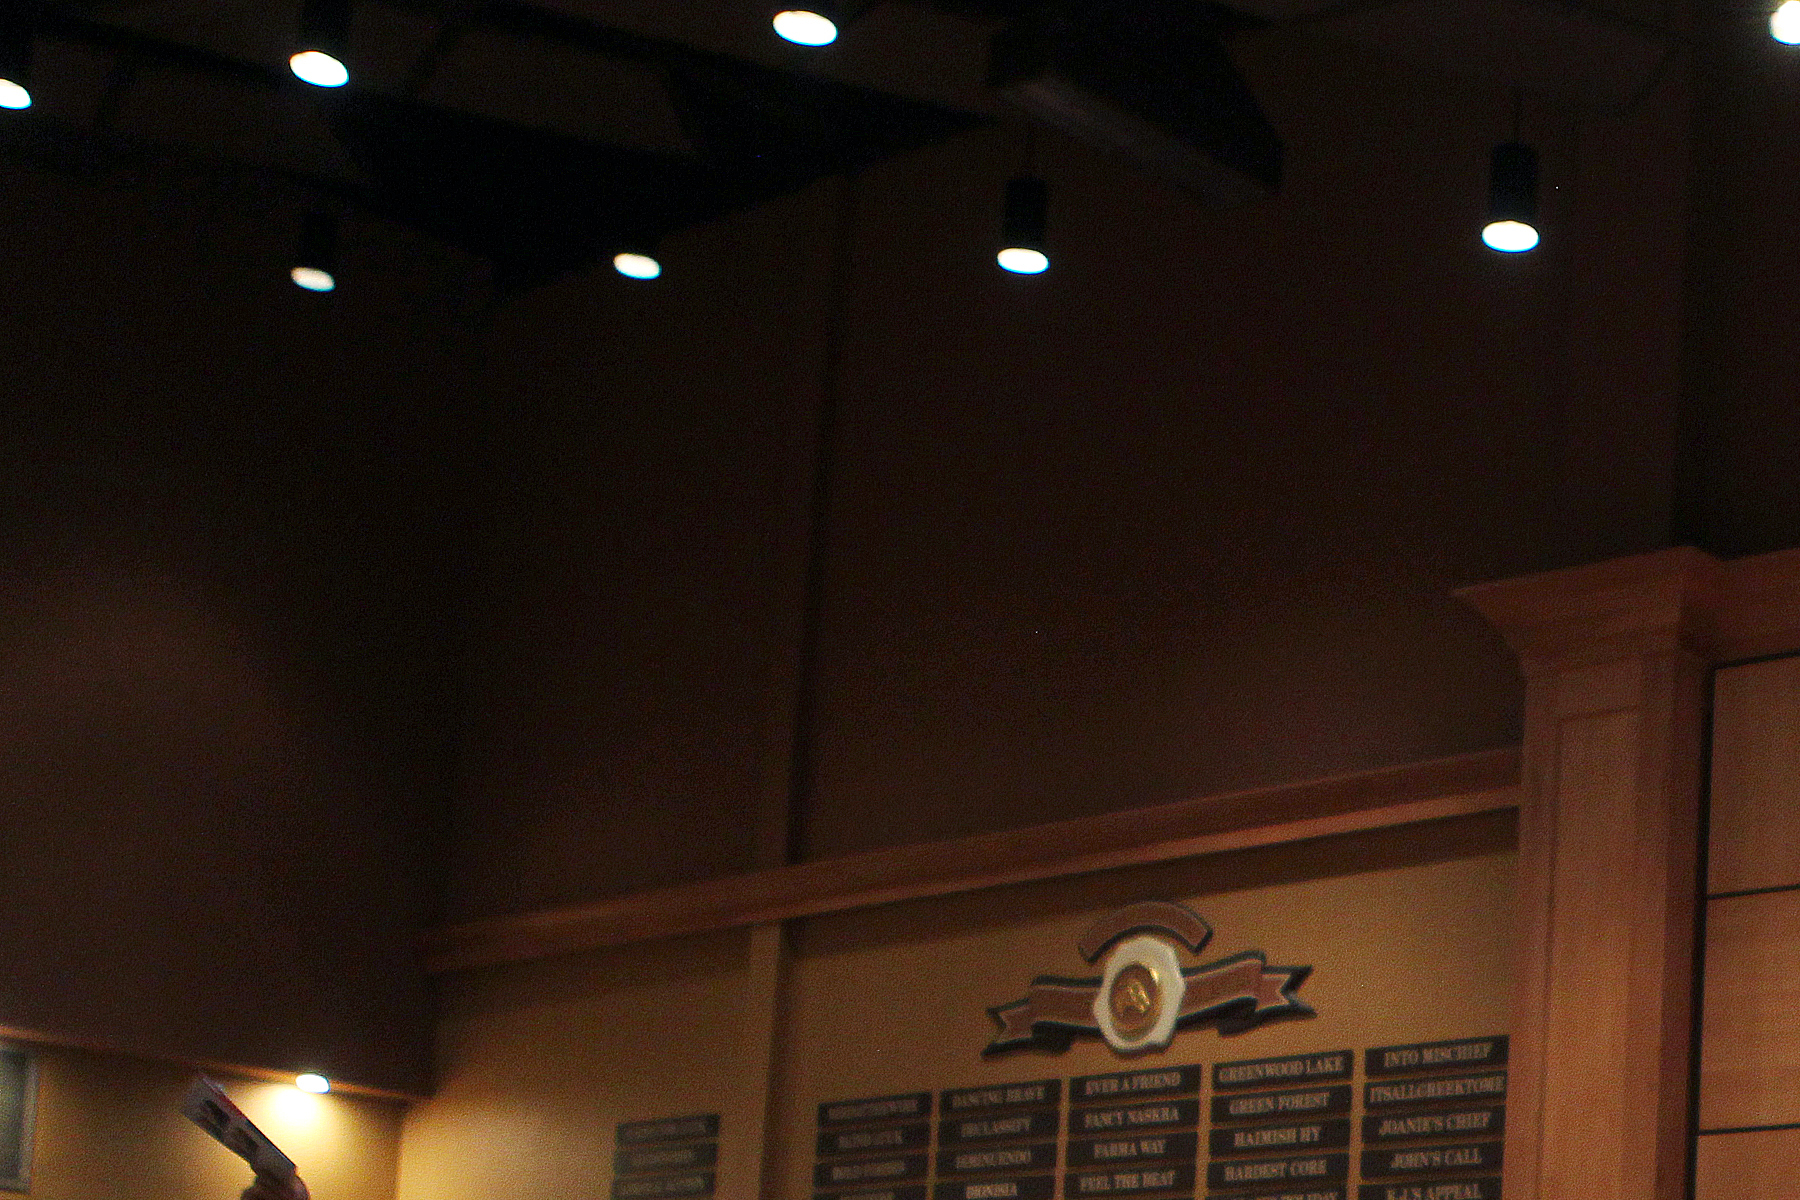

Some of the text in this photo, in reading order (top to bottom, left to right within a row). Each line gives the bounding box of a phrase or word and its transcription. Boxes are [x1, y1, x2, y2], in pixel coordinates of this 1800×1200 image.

[1383, 1042, 1494, 1069] INTO MISCHIEF
[1131, 1070, 1182, 1091] FRIEND
[1218, 1055, 1345, 1083] GREENWOOD LAKE
[1228, 1091, 1331, 1116] GREEN FOREST
[1377, 1111, 1493, 1137] JOANIE'S CHIEF
[1139, 1138, 1167, 1155] WAY
[1389, 1147, 1483, 1170] JOHN'S CALL
[1113, 1172, 1140, 1190] THE
[1223, 1158, 1328, 1182] HARDEST CORE
